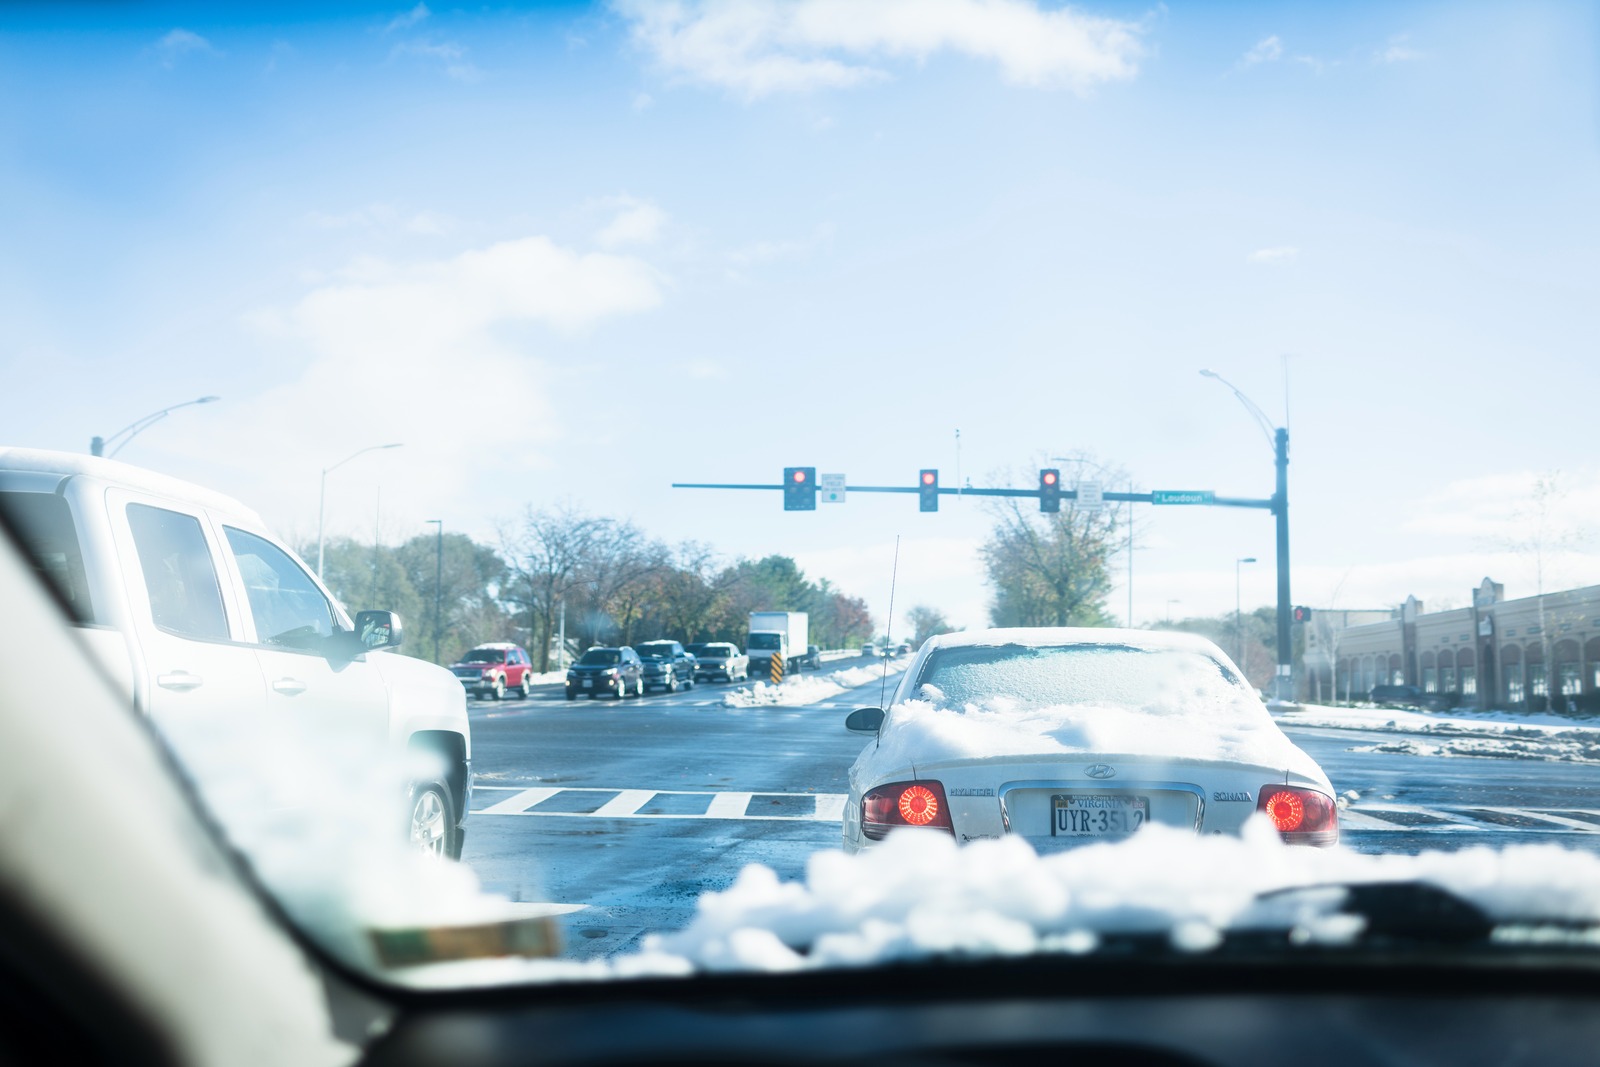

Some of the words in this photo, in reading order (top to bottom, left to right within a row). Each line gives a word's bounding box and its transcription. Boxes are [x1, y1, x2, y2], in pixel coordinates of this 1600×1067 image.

[1161, 493, 1203, 503] Loudoun
[1213, 791, 1253, 802] SONATA
[1077, 800, 1123, 808] VIRGINIA
[1057, 809, 1144, 832] UYR-3512
